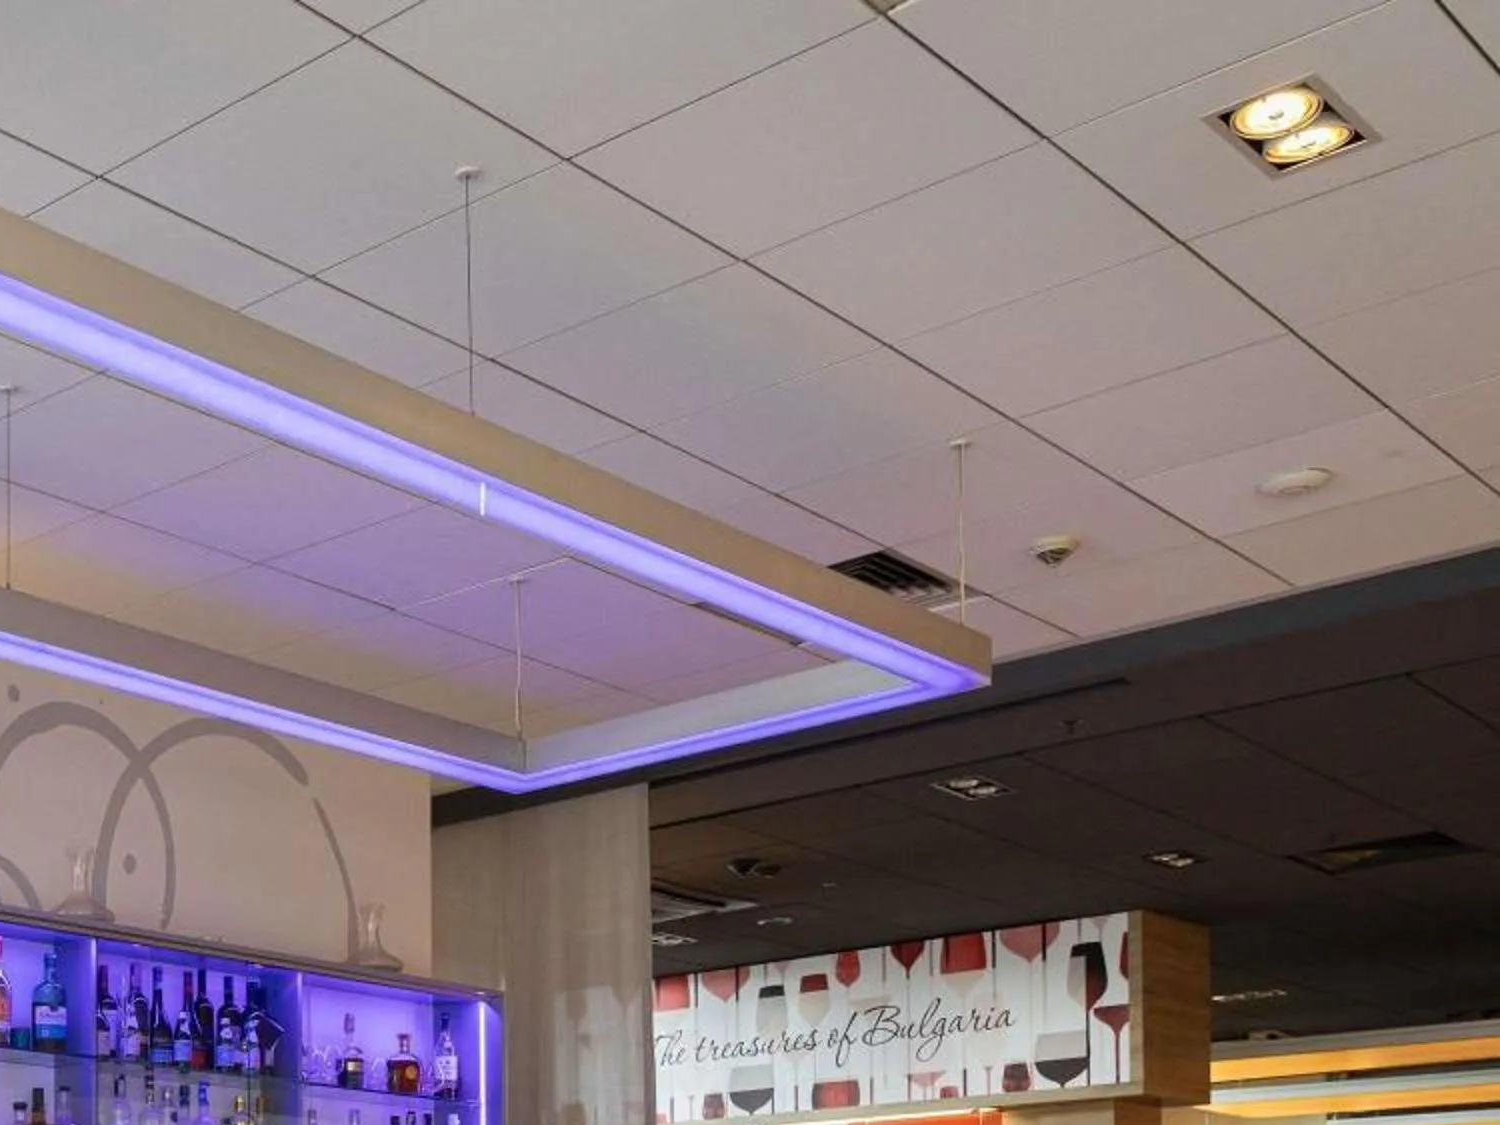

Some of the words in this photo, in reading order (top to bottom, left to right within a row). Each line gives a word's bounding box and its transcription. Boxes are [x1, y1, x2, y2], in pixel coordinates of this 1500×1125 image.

[655, 1030, 689, 1067] The
[694, 1028, 819, 1062] treasures
[827, 1010, 859, 1068] of
[862, 998, 1016, 1062] Bulgaria
